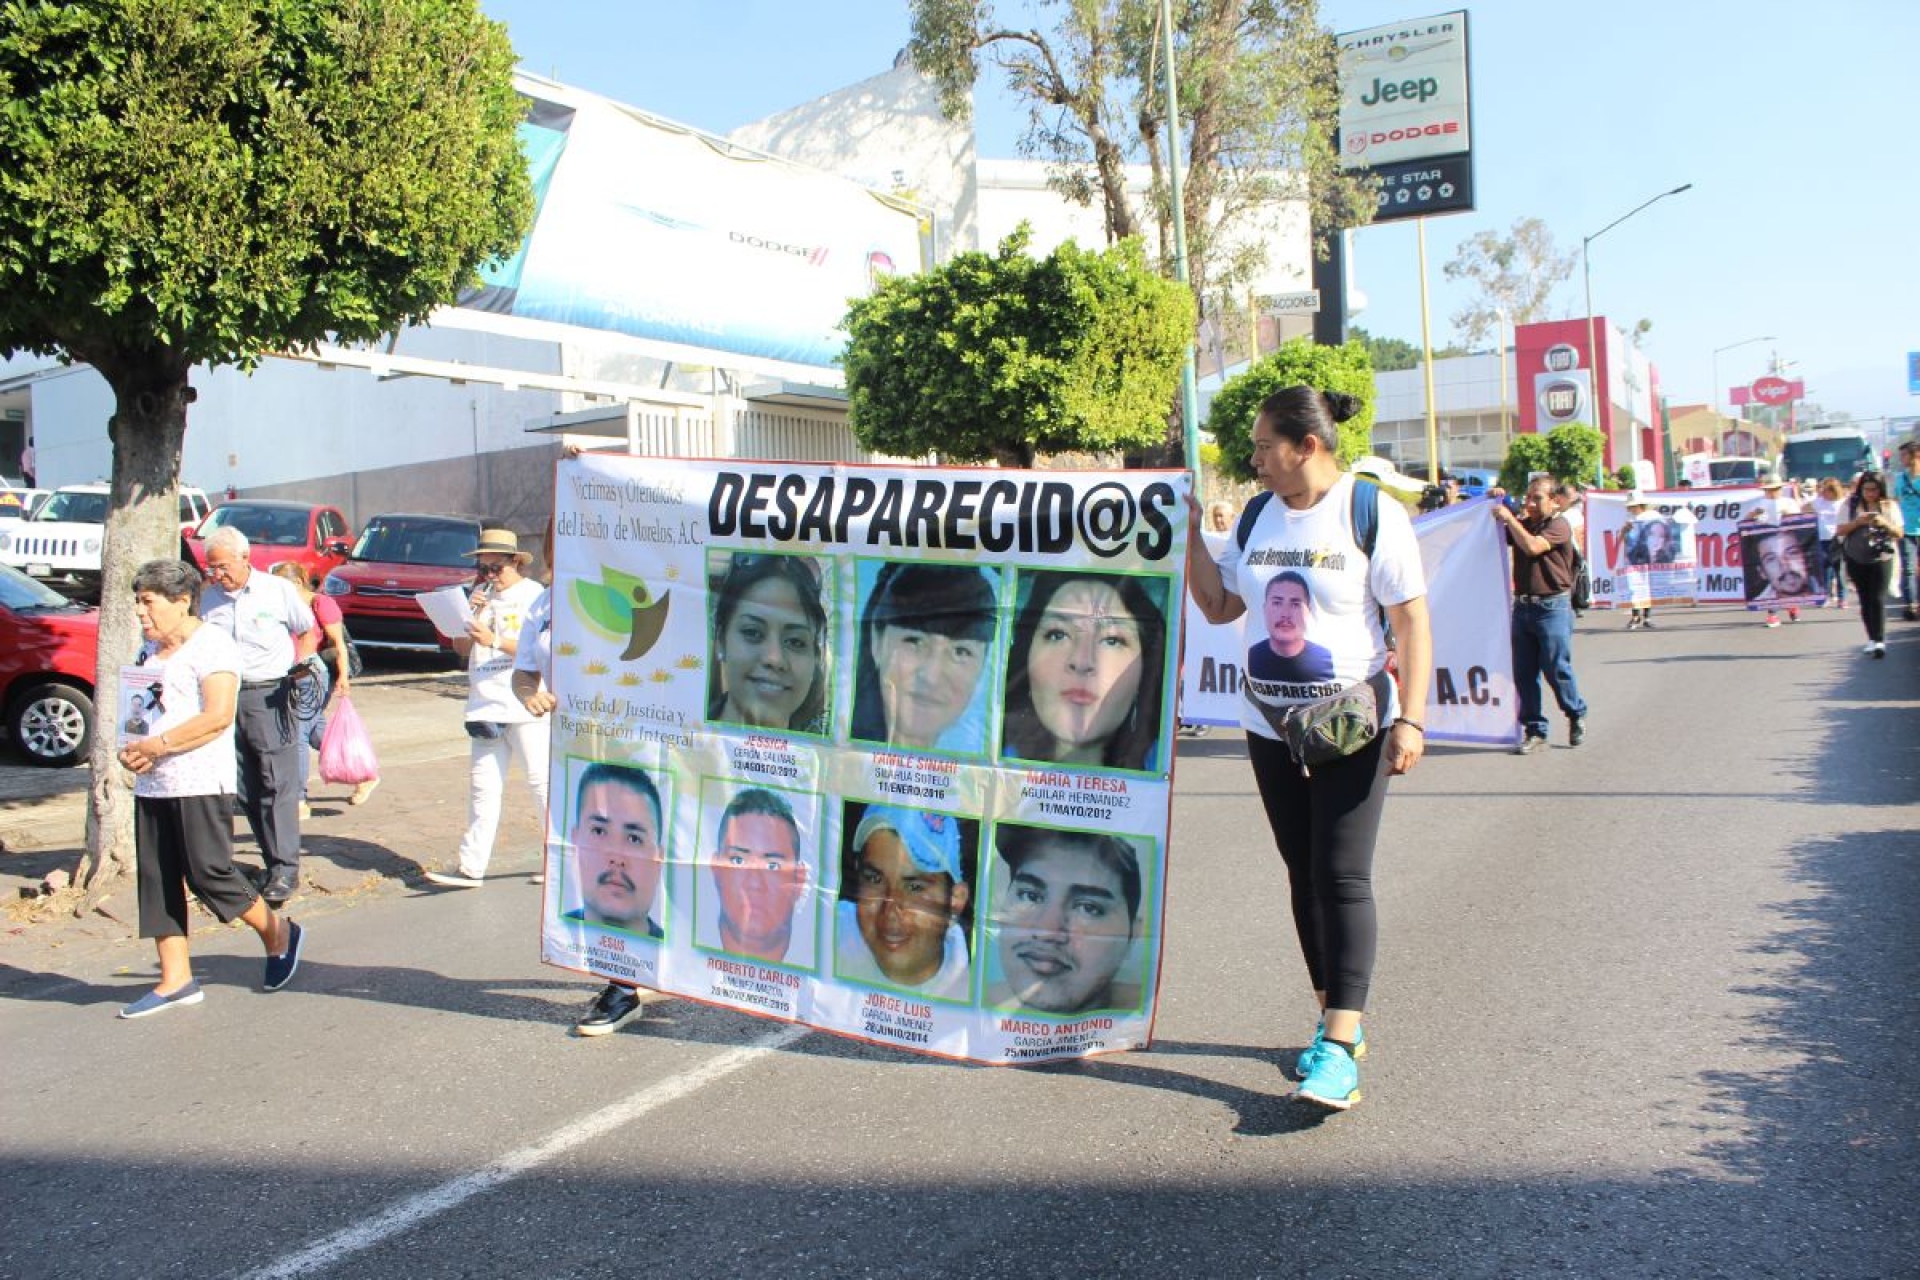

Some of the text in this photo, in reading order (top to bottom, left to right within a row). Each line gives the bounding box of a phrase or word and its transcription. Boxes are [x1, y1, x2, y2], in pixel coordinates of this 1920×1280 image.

[1344, 23, 1454, 50] CHRYSLER
[1361, 76, 1438, 107] Jeep
[1371, 122, 1460, 145] DODGE
[1402, 169, 1443, 185] STAR
[708, 471, 1176, 561] DESAPARECID@S
[1713, 501, 1742, 521] de
[557, 511, 577, 537] del
[614, 514, 628, 540] de
[677, 519, 704, 545] A.C.
[1436, 665, 1500, 706] A.C.
[568, 693, 686, 728] Verdad, Justicia y
[639, 726, 694, 748] Integral
[914, 772, 950, 788] SOTELO
[1076, 775, 1128, 793] TERESA
[1020, 786, 1065, 801] AGUILAR
[1038, 802, 1113, 819] 11/MAYO/2012
[707, 957, 801, 990] ROBERTO CARLOS
[865, 992, 932, 1018] JORGE LUIS
[1001, 1018, 1113, 1036] MARCO ANTONIO
